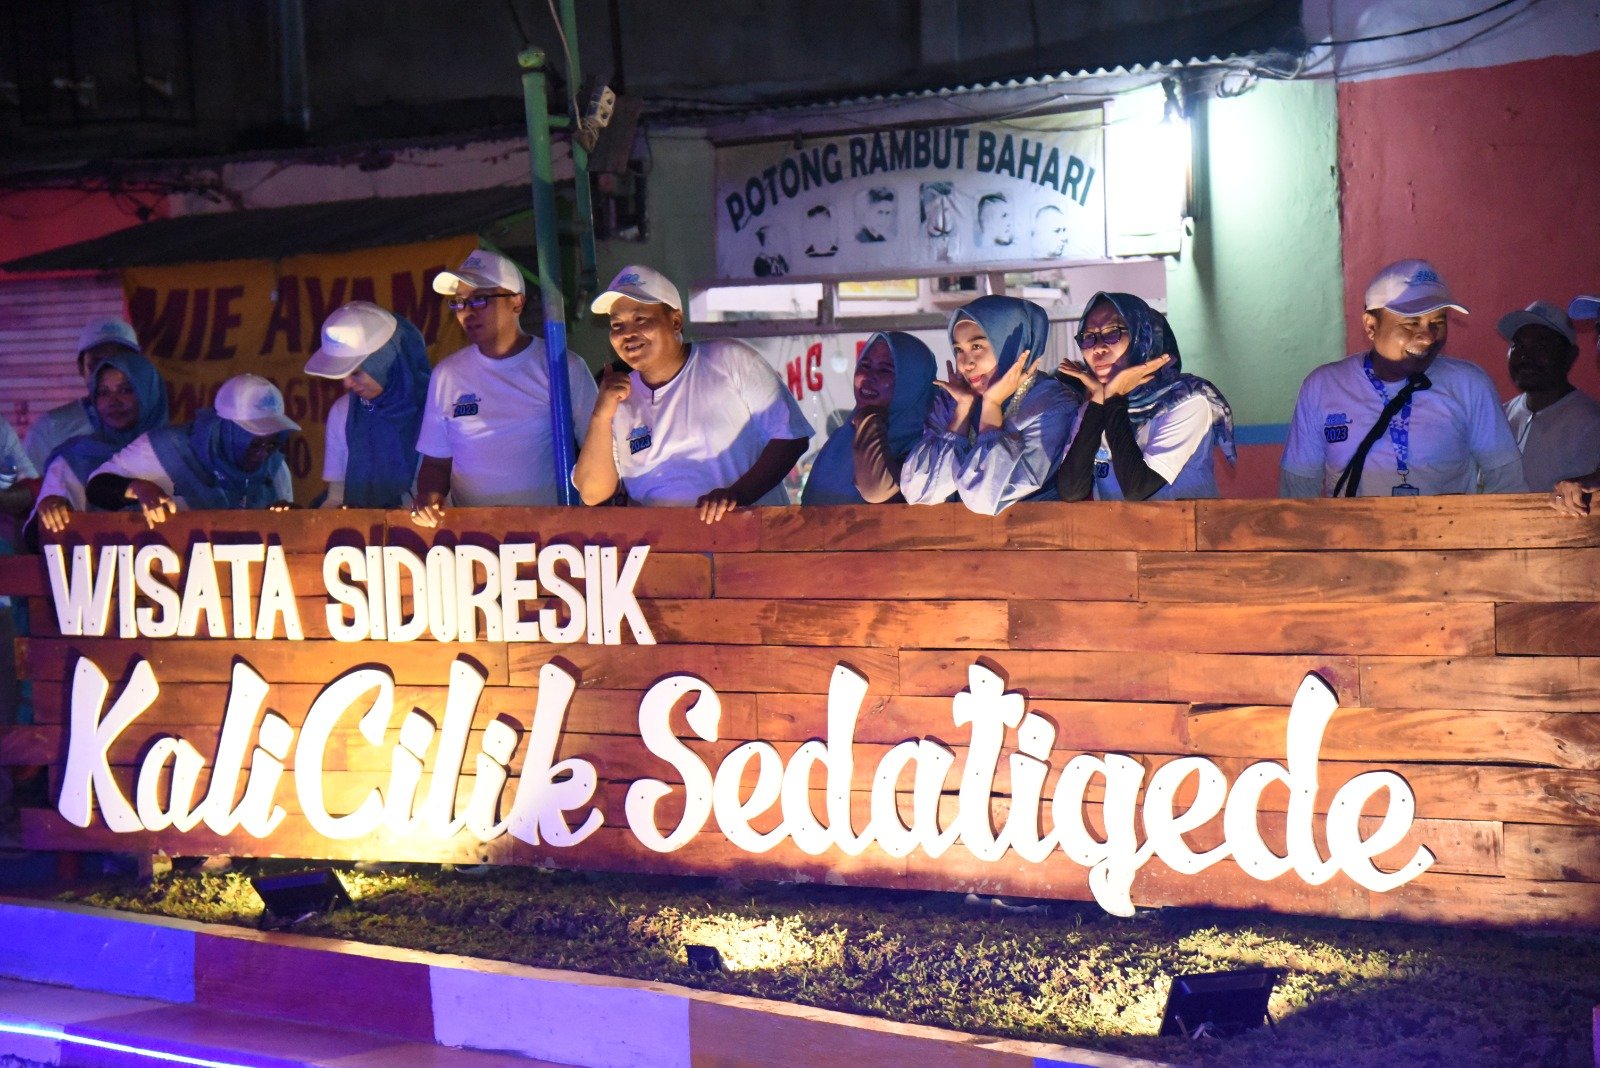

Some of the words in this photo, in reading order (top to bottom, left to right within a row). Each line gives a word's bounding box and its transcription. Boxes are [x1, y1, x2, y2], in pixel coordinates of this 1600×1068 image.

[725, 142, 842, 233] POTONG
[849, 127, 970, 178] RAMBUT
[976, 130, 1096, 207] BAHARI
[132, 285, 245, 361] MIE
[777, 342, 824, 401] NG
[454, 403, 478, 417] 2023
[1325, 426, 1347, 442] 2023
[630, 435, 651, 453] 2023
[1096, 463, 1108, 477] 23
[43, 541, 305, 641] WISATA
[323, 542, 657, 646] SIDORESIK
[624, 659, 1436, 919] Sedatigede
